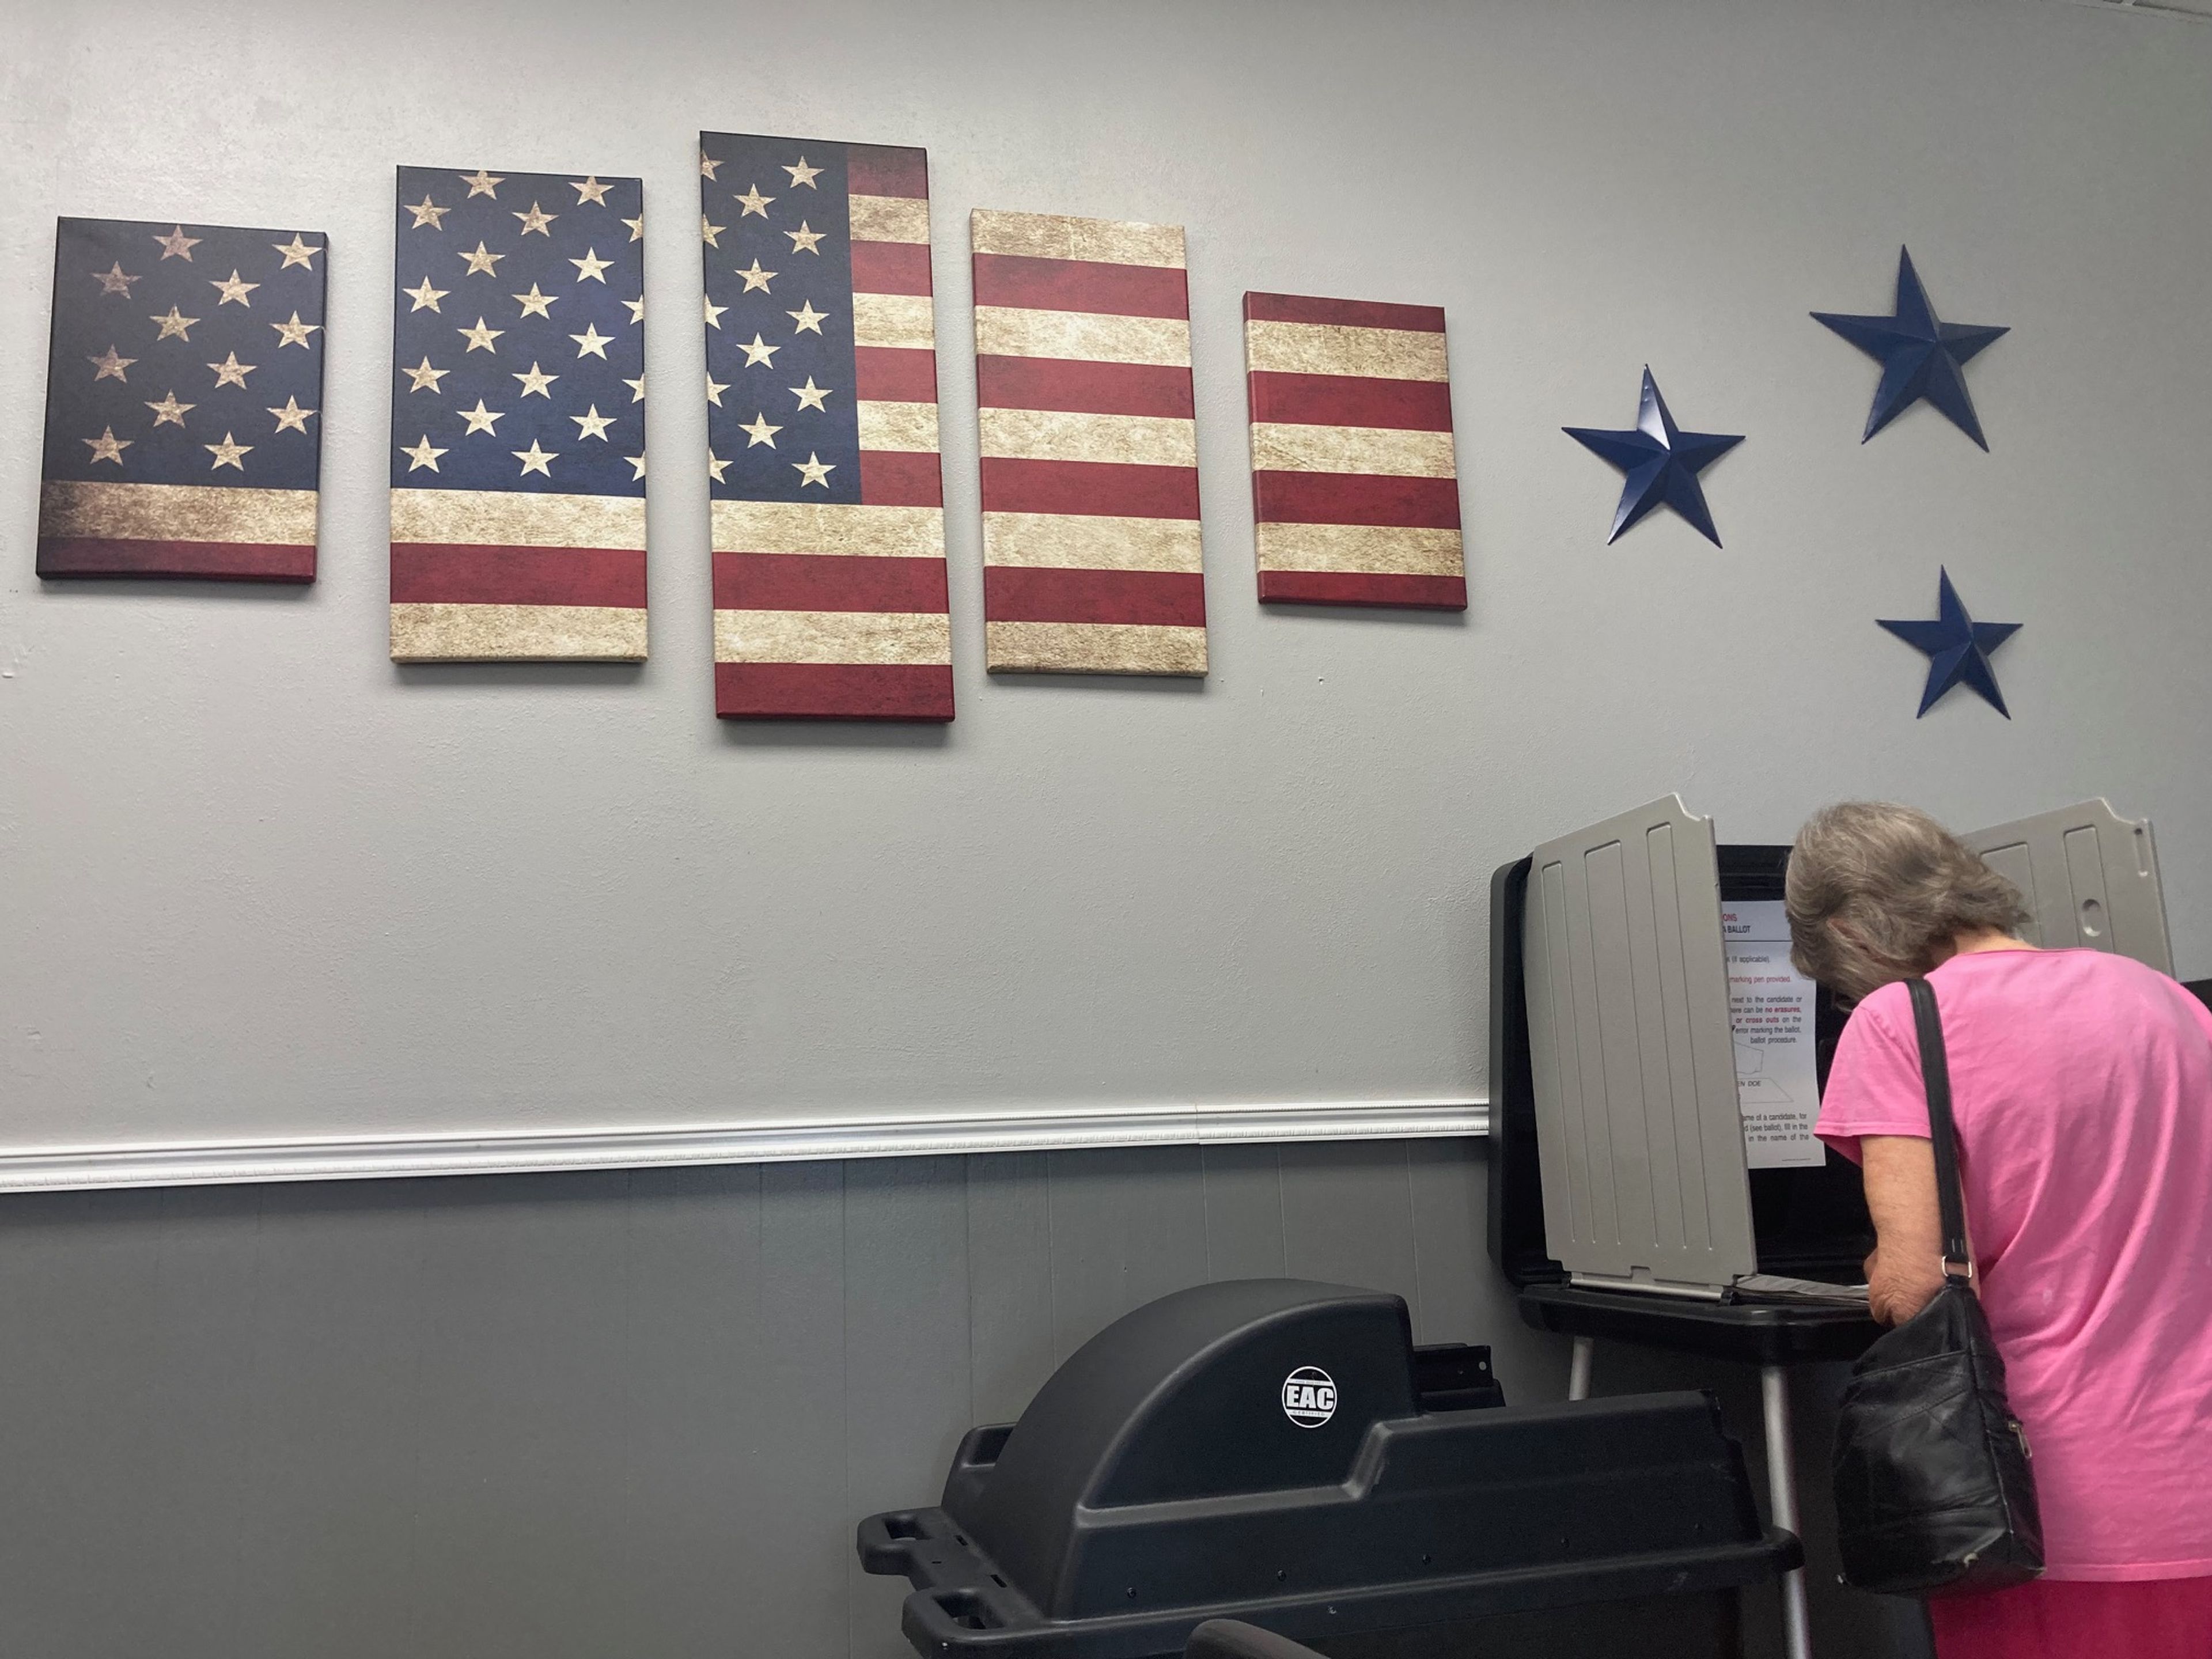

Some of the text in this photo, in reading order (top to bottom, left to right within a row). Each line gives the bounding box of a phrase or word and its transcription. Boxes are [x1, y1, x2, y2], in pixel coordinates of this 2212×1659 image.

[1721, 914, 1737, 922] ONS
[1728, 925, 1751, 933] BALLOT
[1729, 976, 1752, 984] marking
[1750, 1124, 1763, 1132] (see
[1790, 1133, 1796, 1141] of
[1287, 1385, 1334, 1410] EAC
